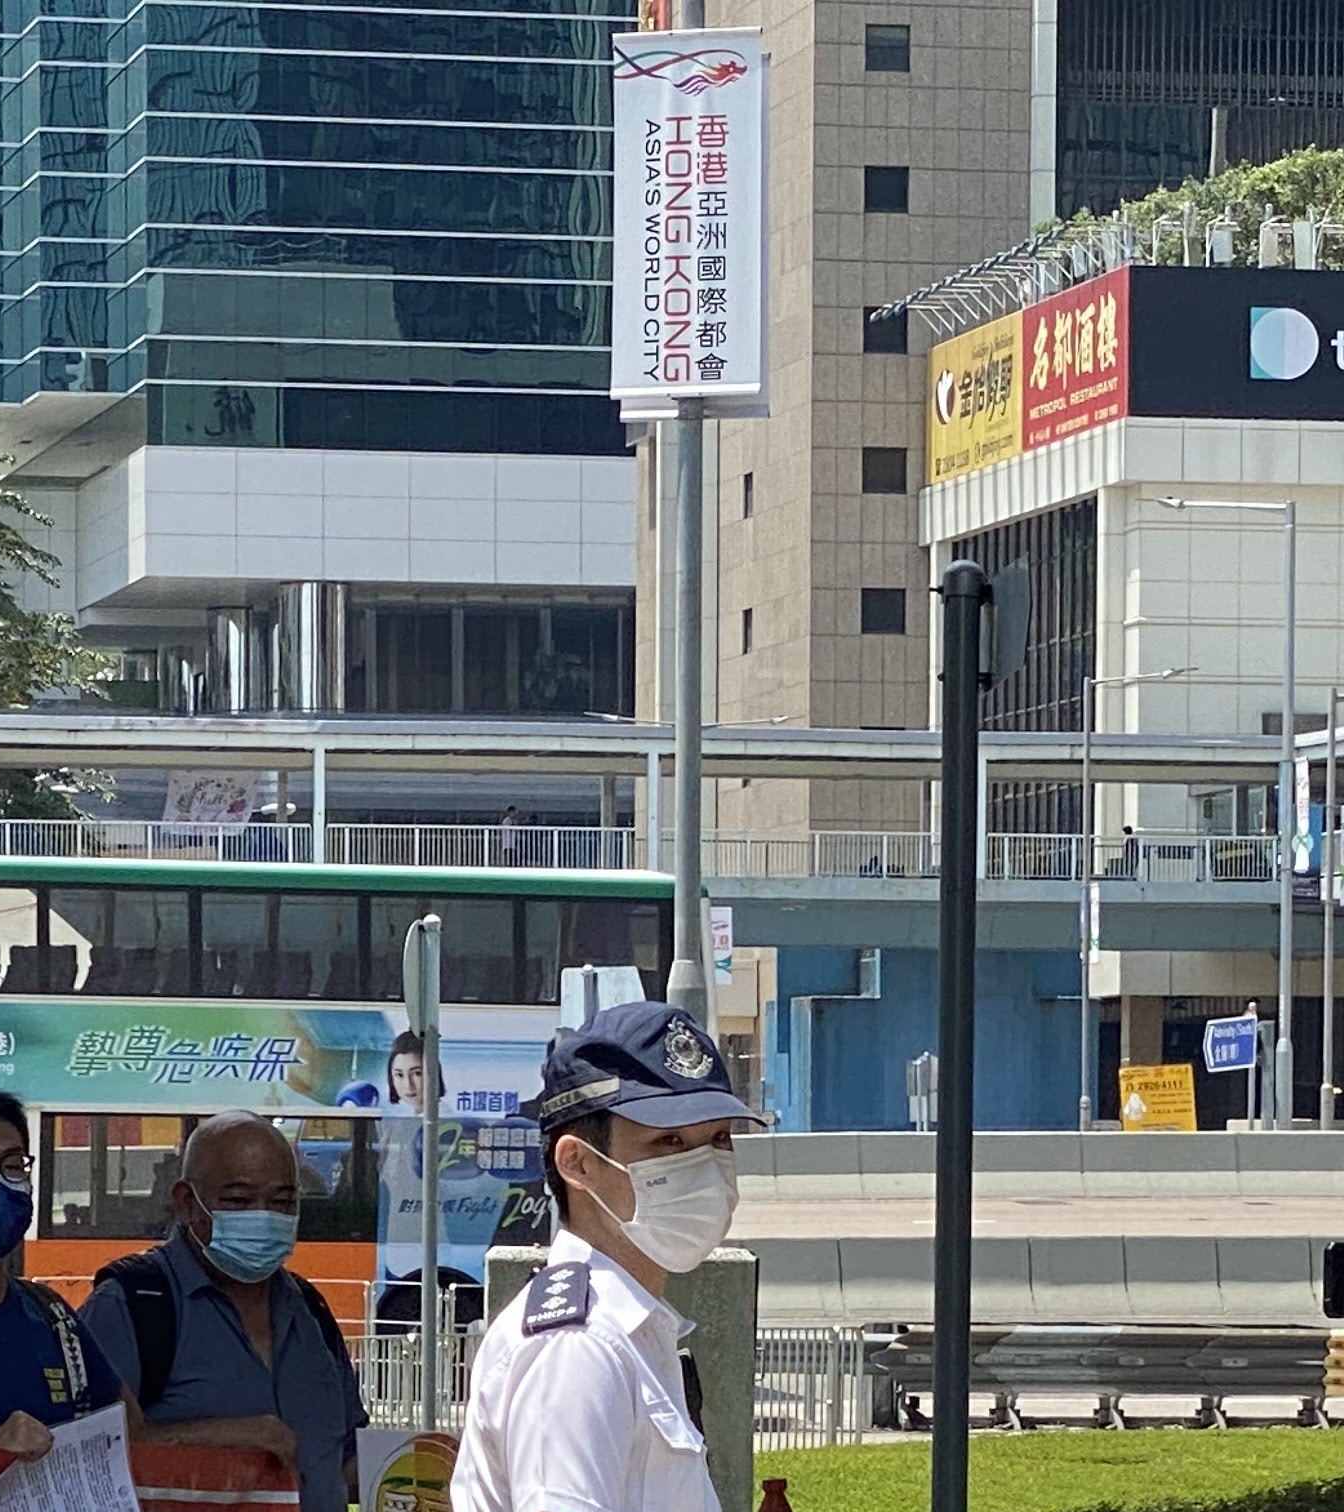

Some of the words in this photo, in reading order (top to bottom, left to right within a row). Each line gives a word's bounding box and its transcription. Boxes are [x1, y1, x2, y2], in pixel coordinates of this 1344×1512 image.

[645, 119, 661, 206] ASIA'S
[664, 116, 693, 243] HONG
[644, 213, 660, 311] WORLD
[695, 114, 729, 381] 香港亞洲國際都會
[643, 319, 660, 381] CITY
[663, 255, 692, 382] KONG
[1029, 291, 1118, 391] 名都酒樓
